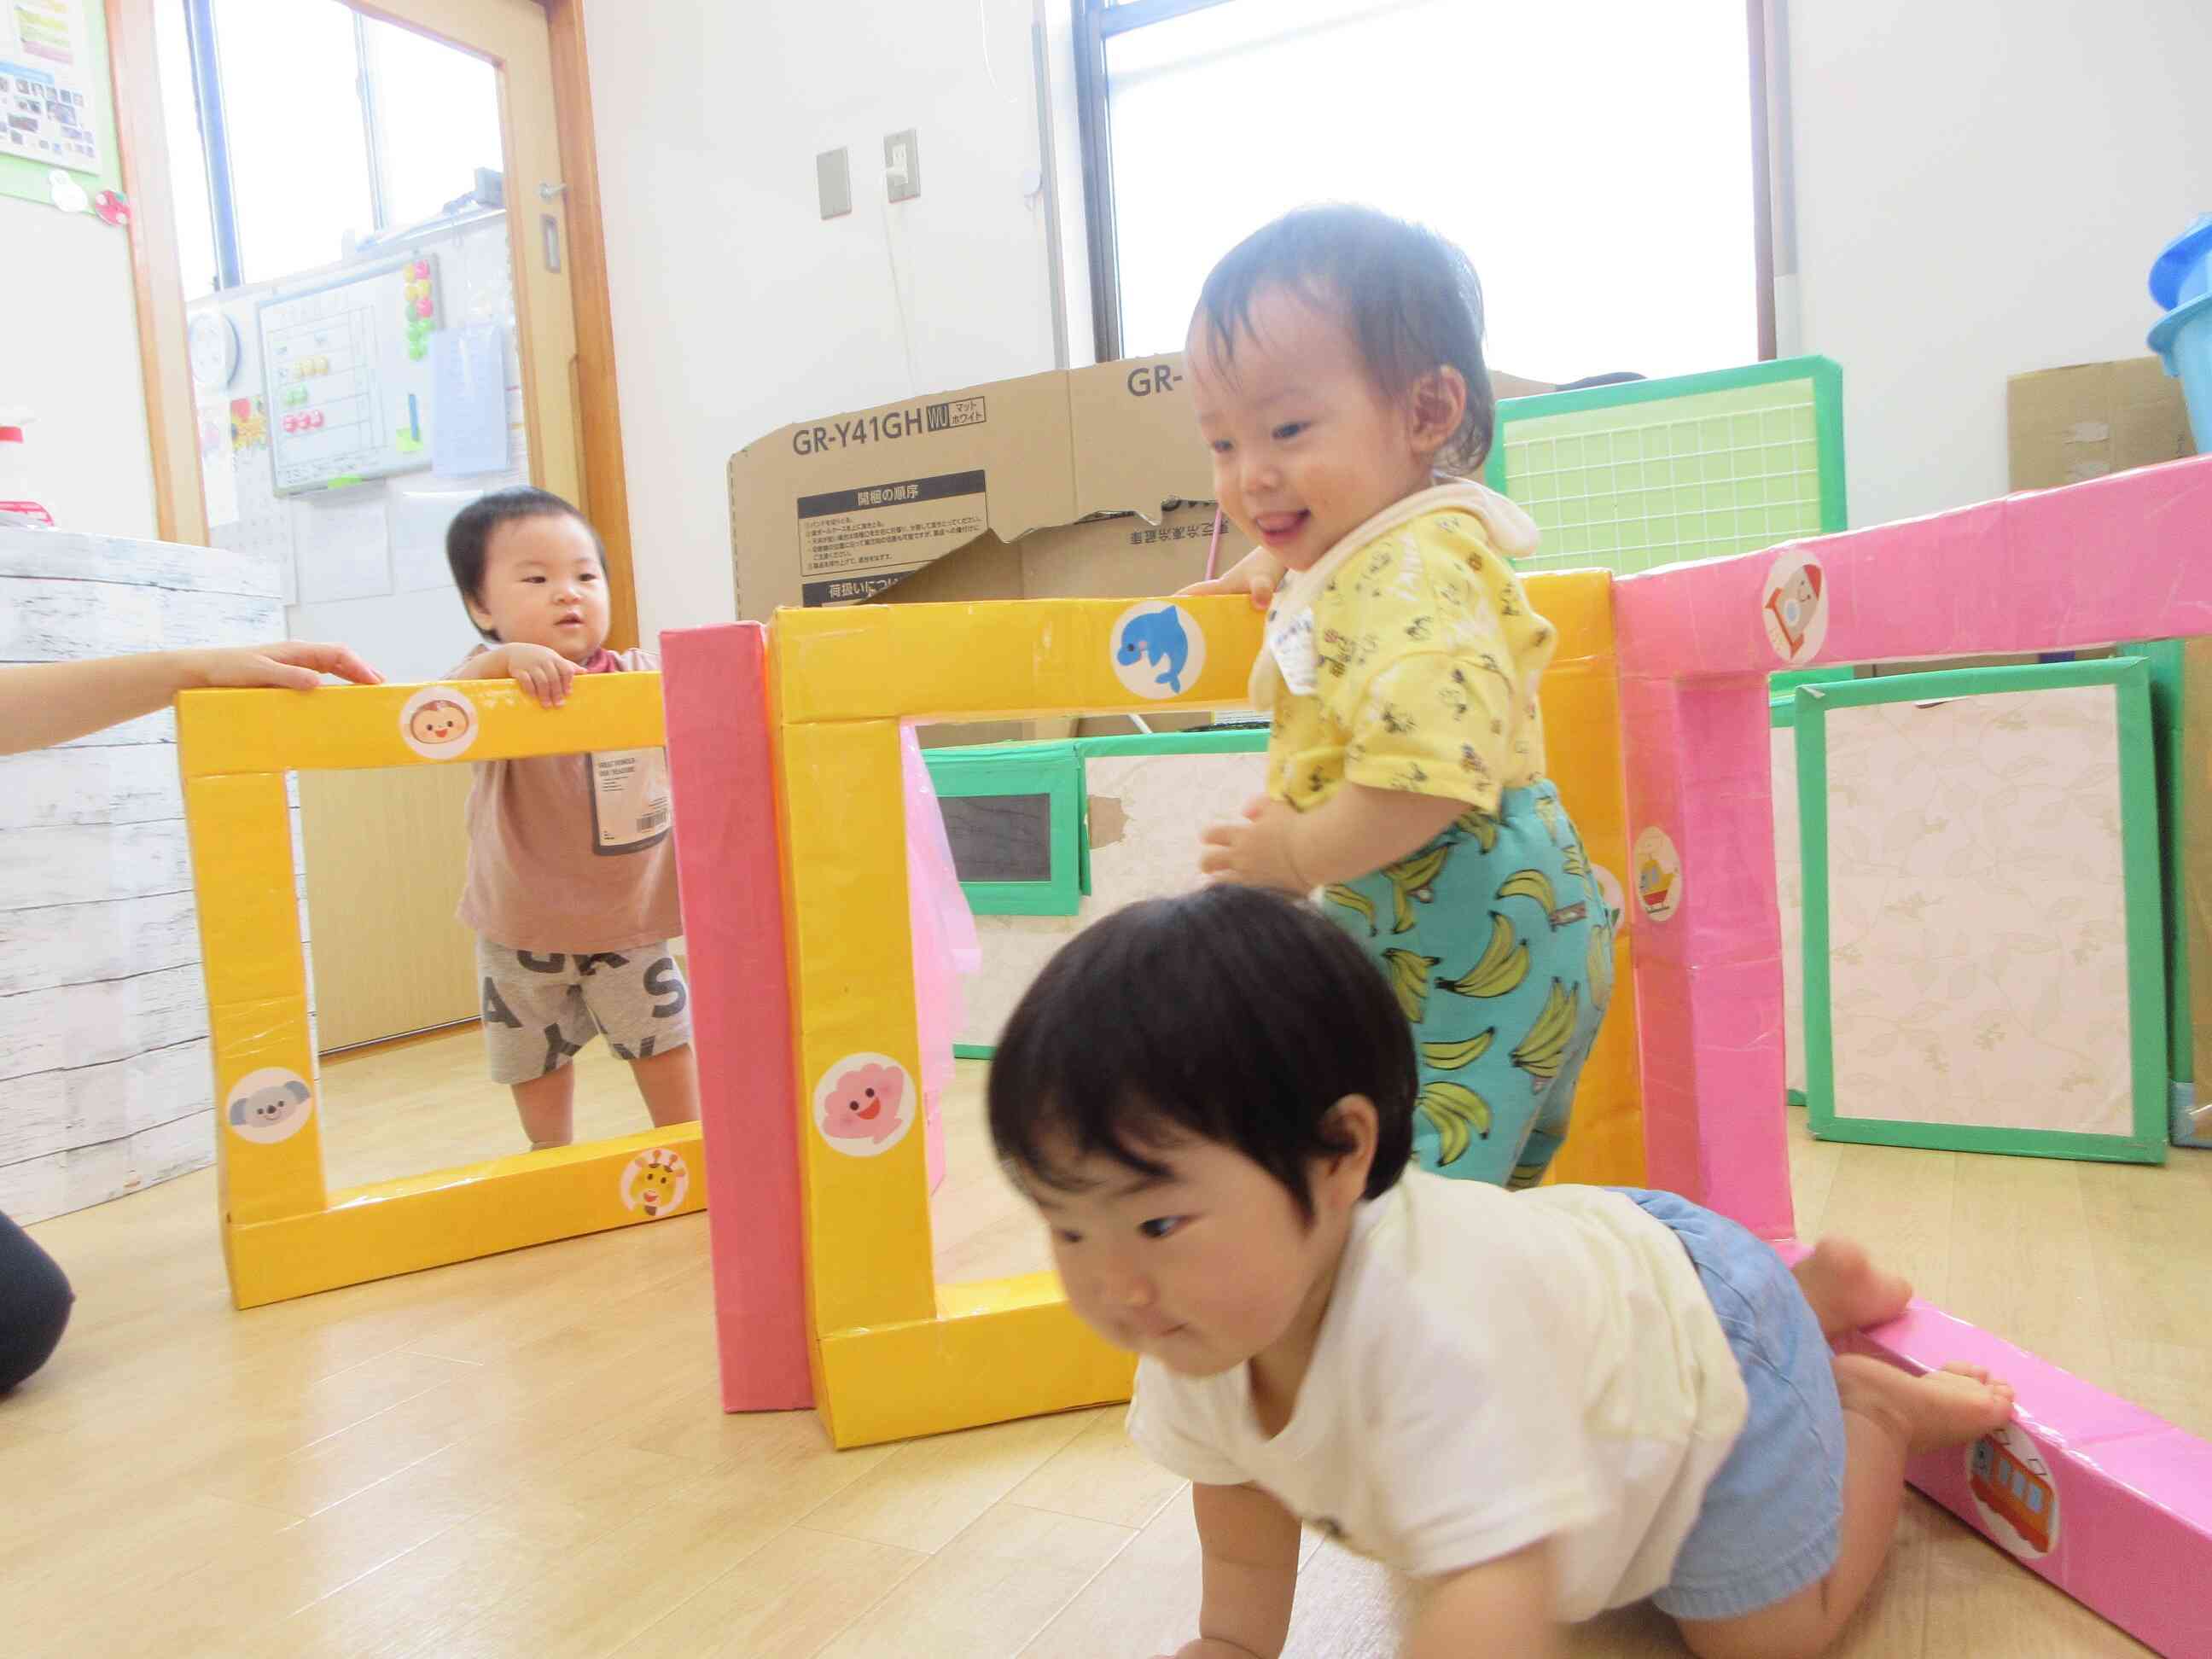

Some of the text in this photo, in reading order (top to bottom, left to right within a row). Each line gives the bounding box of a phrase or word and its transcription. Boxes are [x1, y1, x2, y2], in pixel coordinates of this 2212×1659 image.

[1127, 364, 1183, 396] GR-
[793, 408, 923, 456] GR-Y41GH
[952, 413, 981, 425] ホワイト
[643, 957, 686, 1018] S
